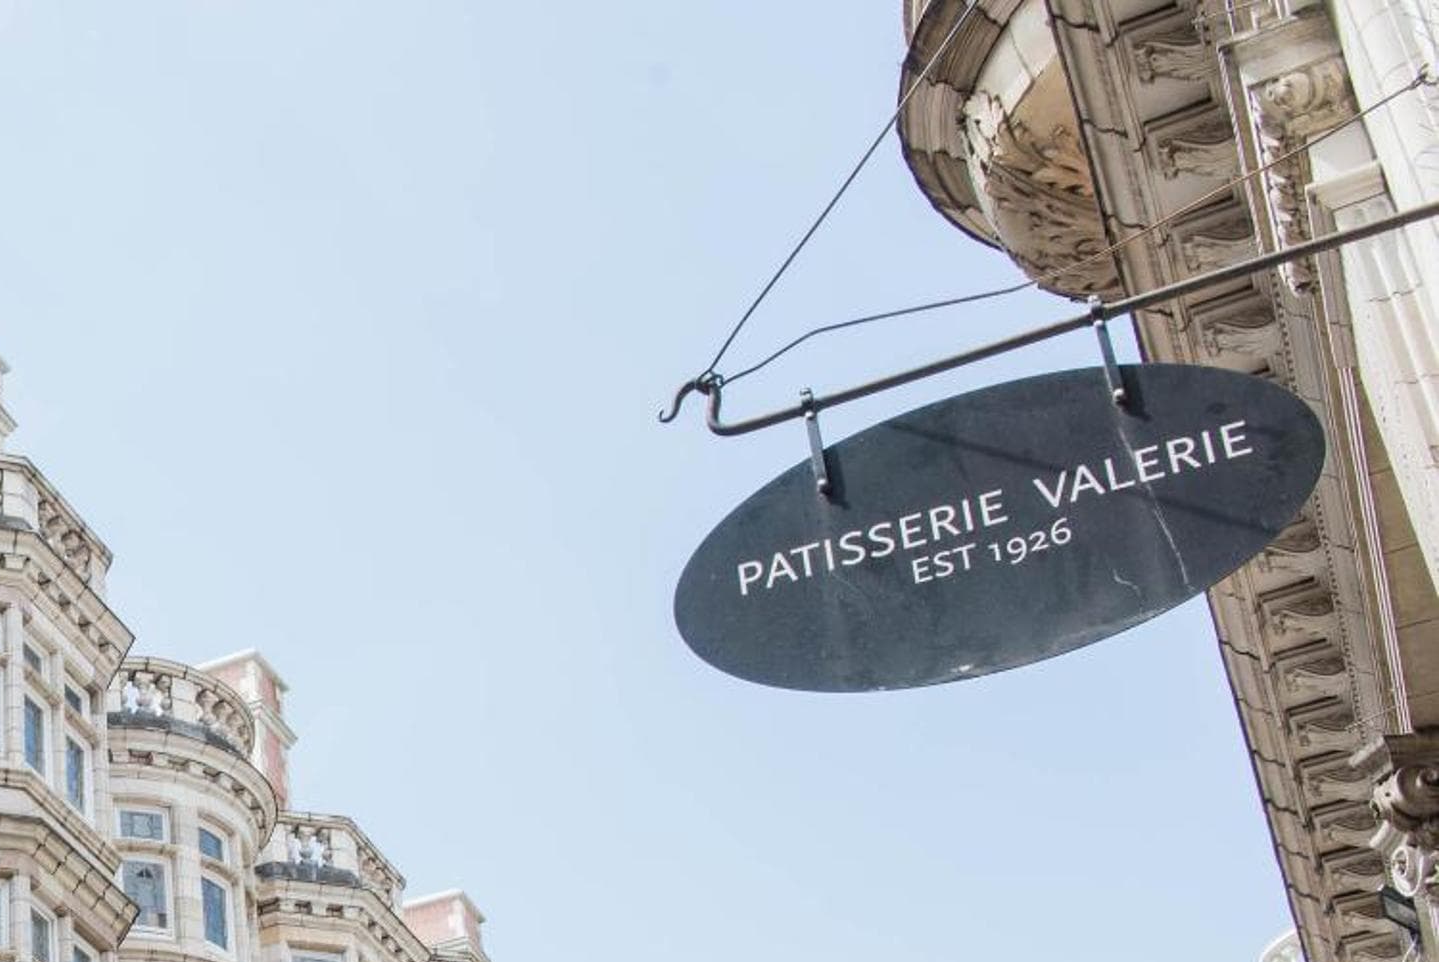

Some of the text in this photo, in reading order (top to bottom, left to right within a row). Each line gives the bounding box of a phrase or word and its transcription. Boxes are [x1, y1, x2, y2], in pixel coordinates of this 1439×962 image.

[737, 420, 1253, 596] PATISSERIE VALERIE
[911, 517, 1072, 584] EST 1926
